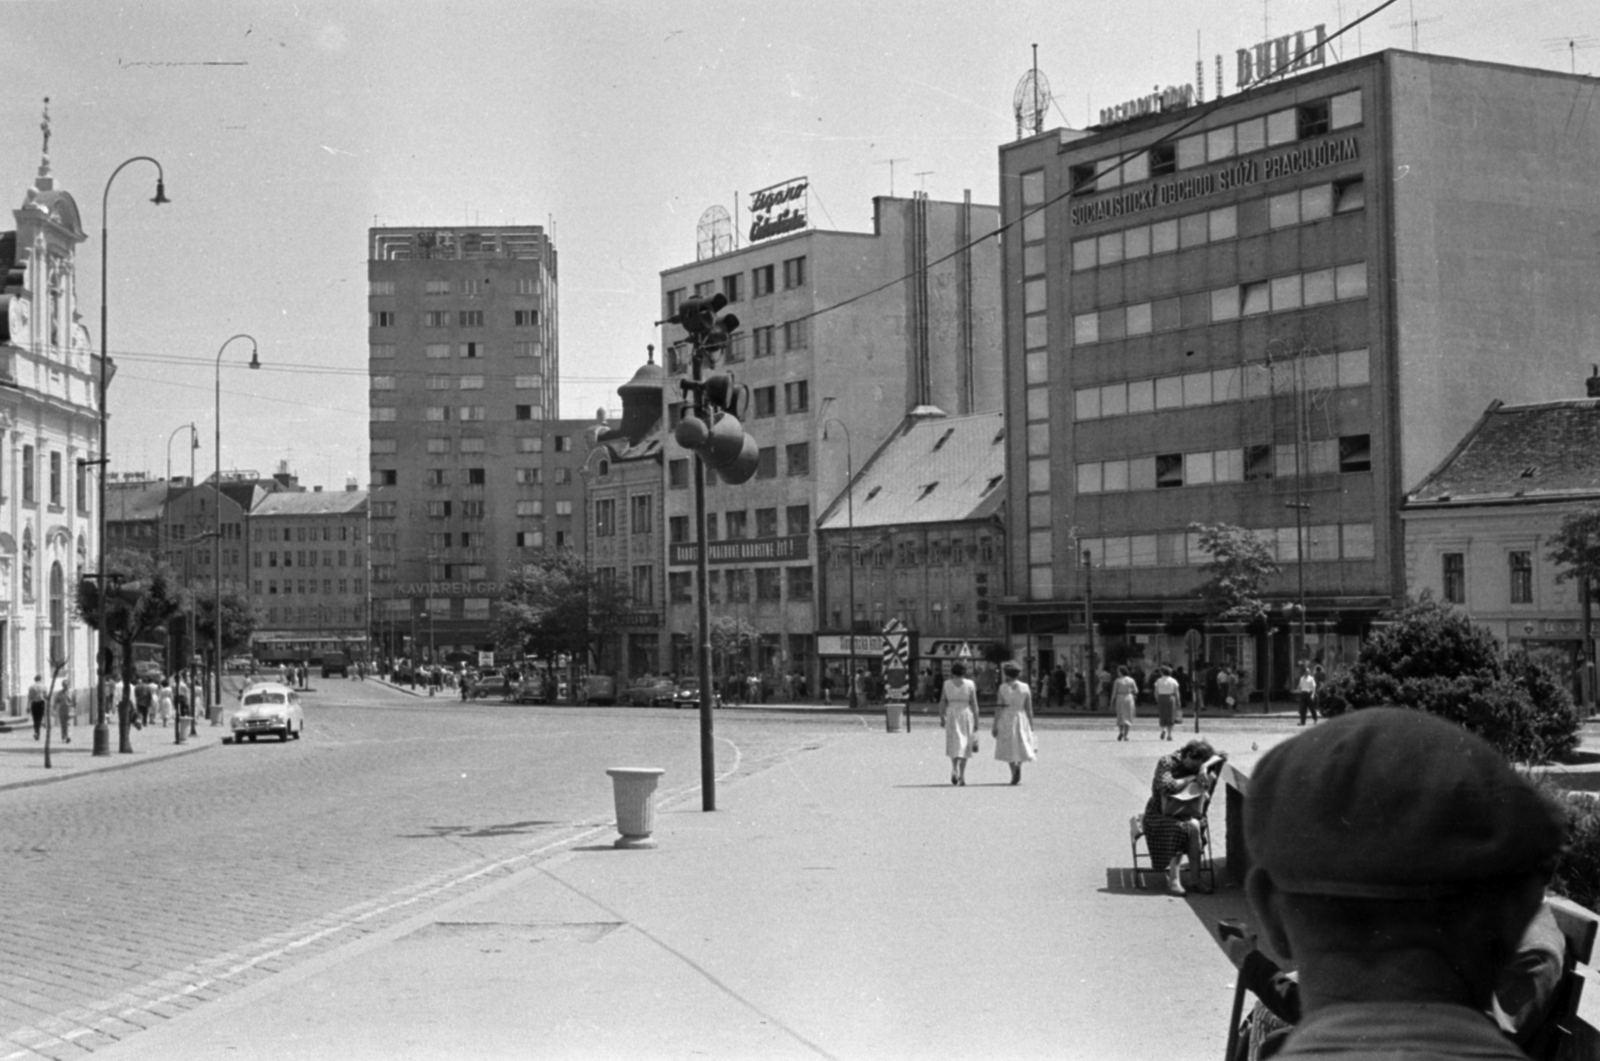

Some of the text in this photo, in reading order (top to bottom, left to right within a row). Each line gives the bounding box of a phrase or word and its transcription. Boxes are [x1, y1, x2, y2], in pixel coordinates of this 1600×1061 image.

[1236, 24, 1325, 88] DUNAJ
[1071, 136, 1360, 226] SOCIALISTICKÝ OBCHOD SLÚŽI PRACUJÚCIM
